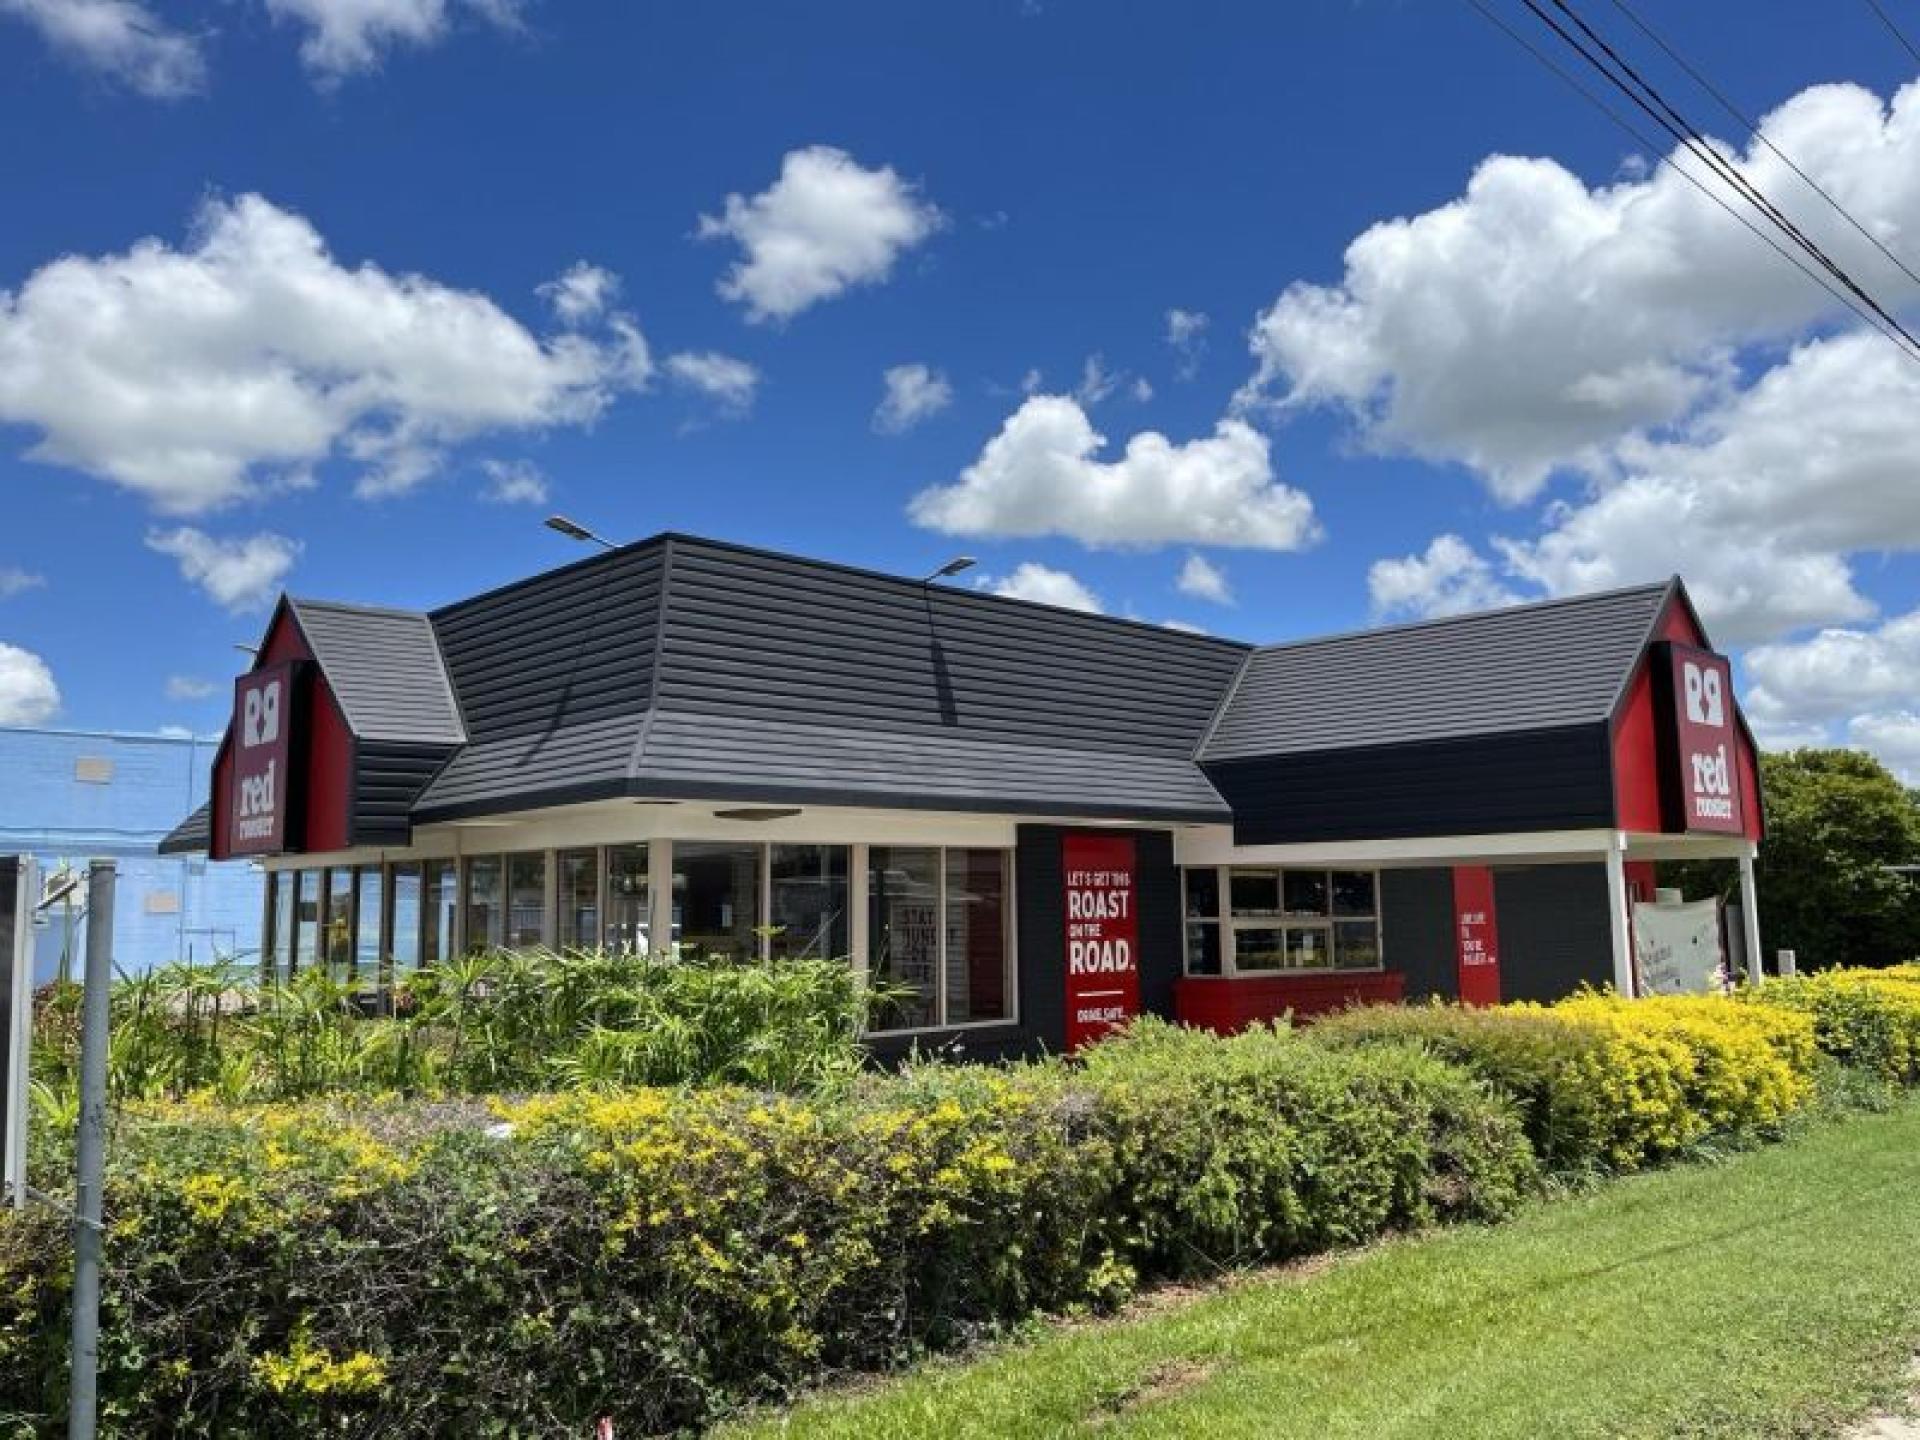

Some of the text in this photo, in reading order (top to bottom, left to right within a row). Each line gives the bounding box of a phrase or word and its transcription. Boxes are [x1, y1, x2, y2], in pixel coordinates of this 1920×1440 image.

[240, 758, 275, 816] red
[1691, 744, 1729, 795] red
[1094, 871, 1109, 886] GET
[1068, 890, 1129, 919] ROAST
[1070, 938, 1136, 975] ROAD.
